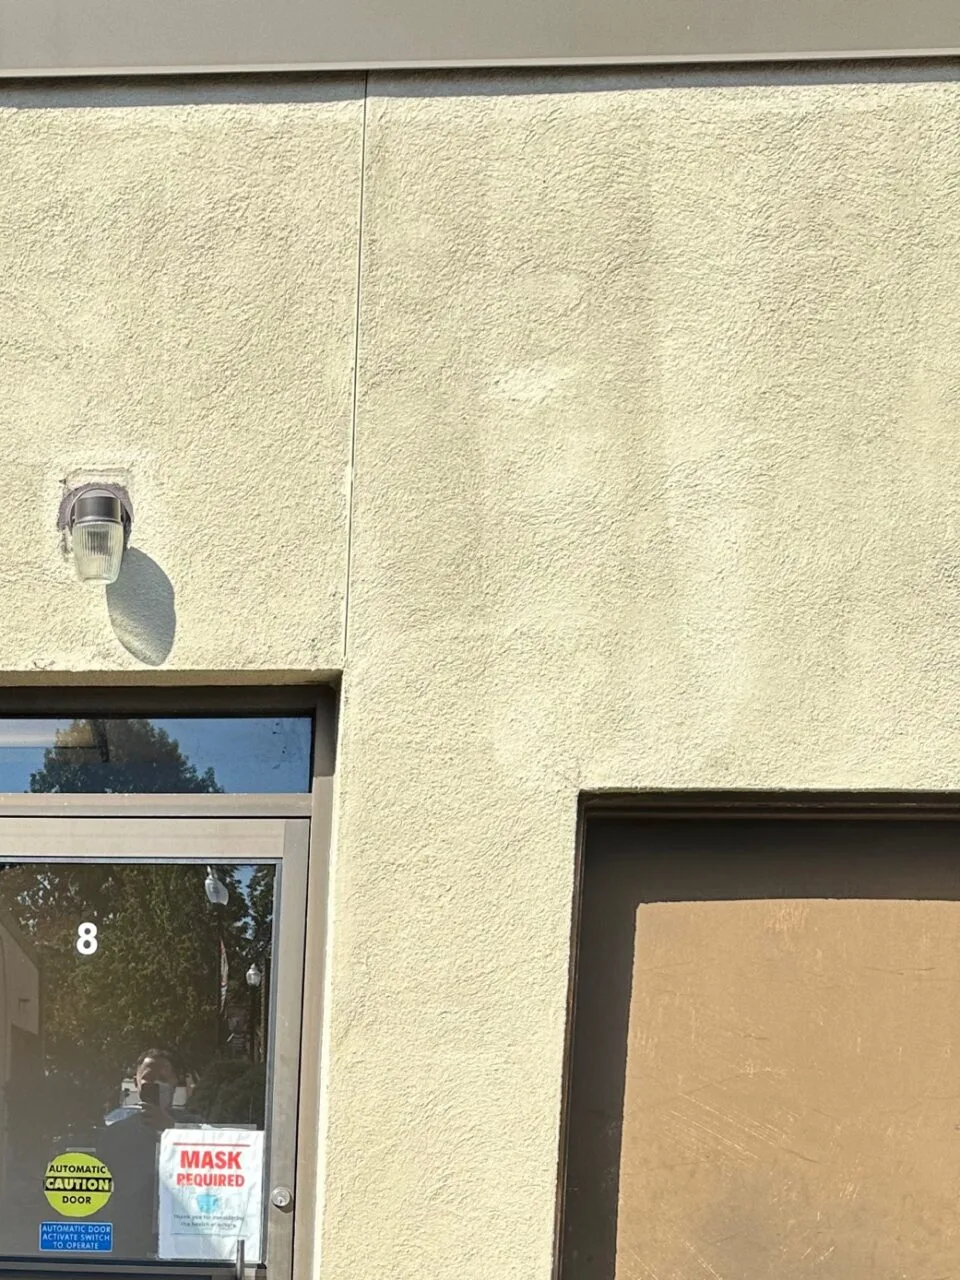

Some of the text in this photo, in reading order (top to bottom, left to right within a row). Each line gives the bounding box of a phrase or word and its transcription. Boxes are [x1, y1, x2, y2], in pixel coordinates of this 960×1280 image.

[76, 921, 98, 955] 8
[180, 1150, 242, 1169] MASK
[49, 1165, 106, 1174] AUTOMATIC
[45, 1178, 109, 1190] CAUTION
[62, 1196, 91, 1204] DOOR
